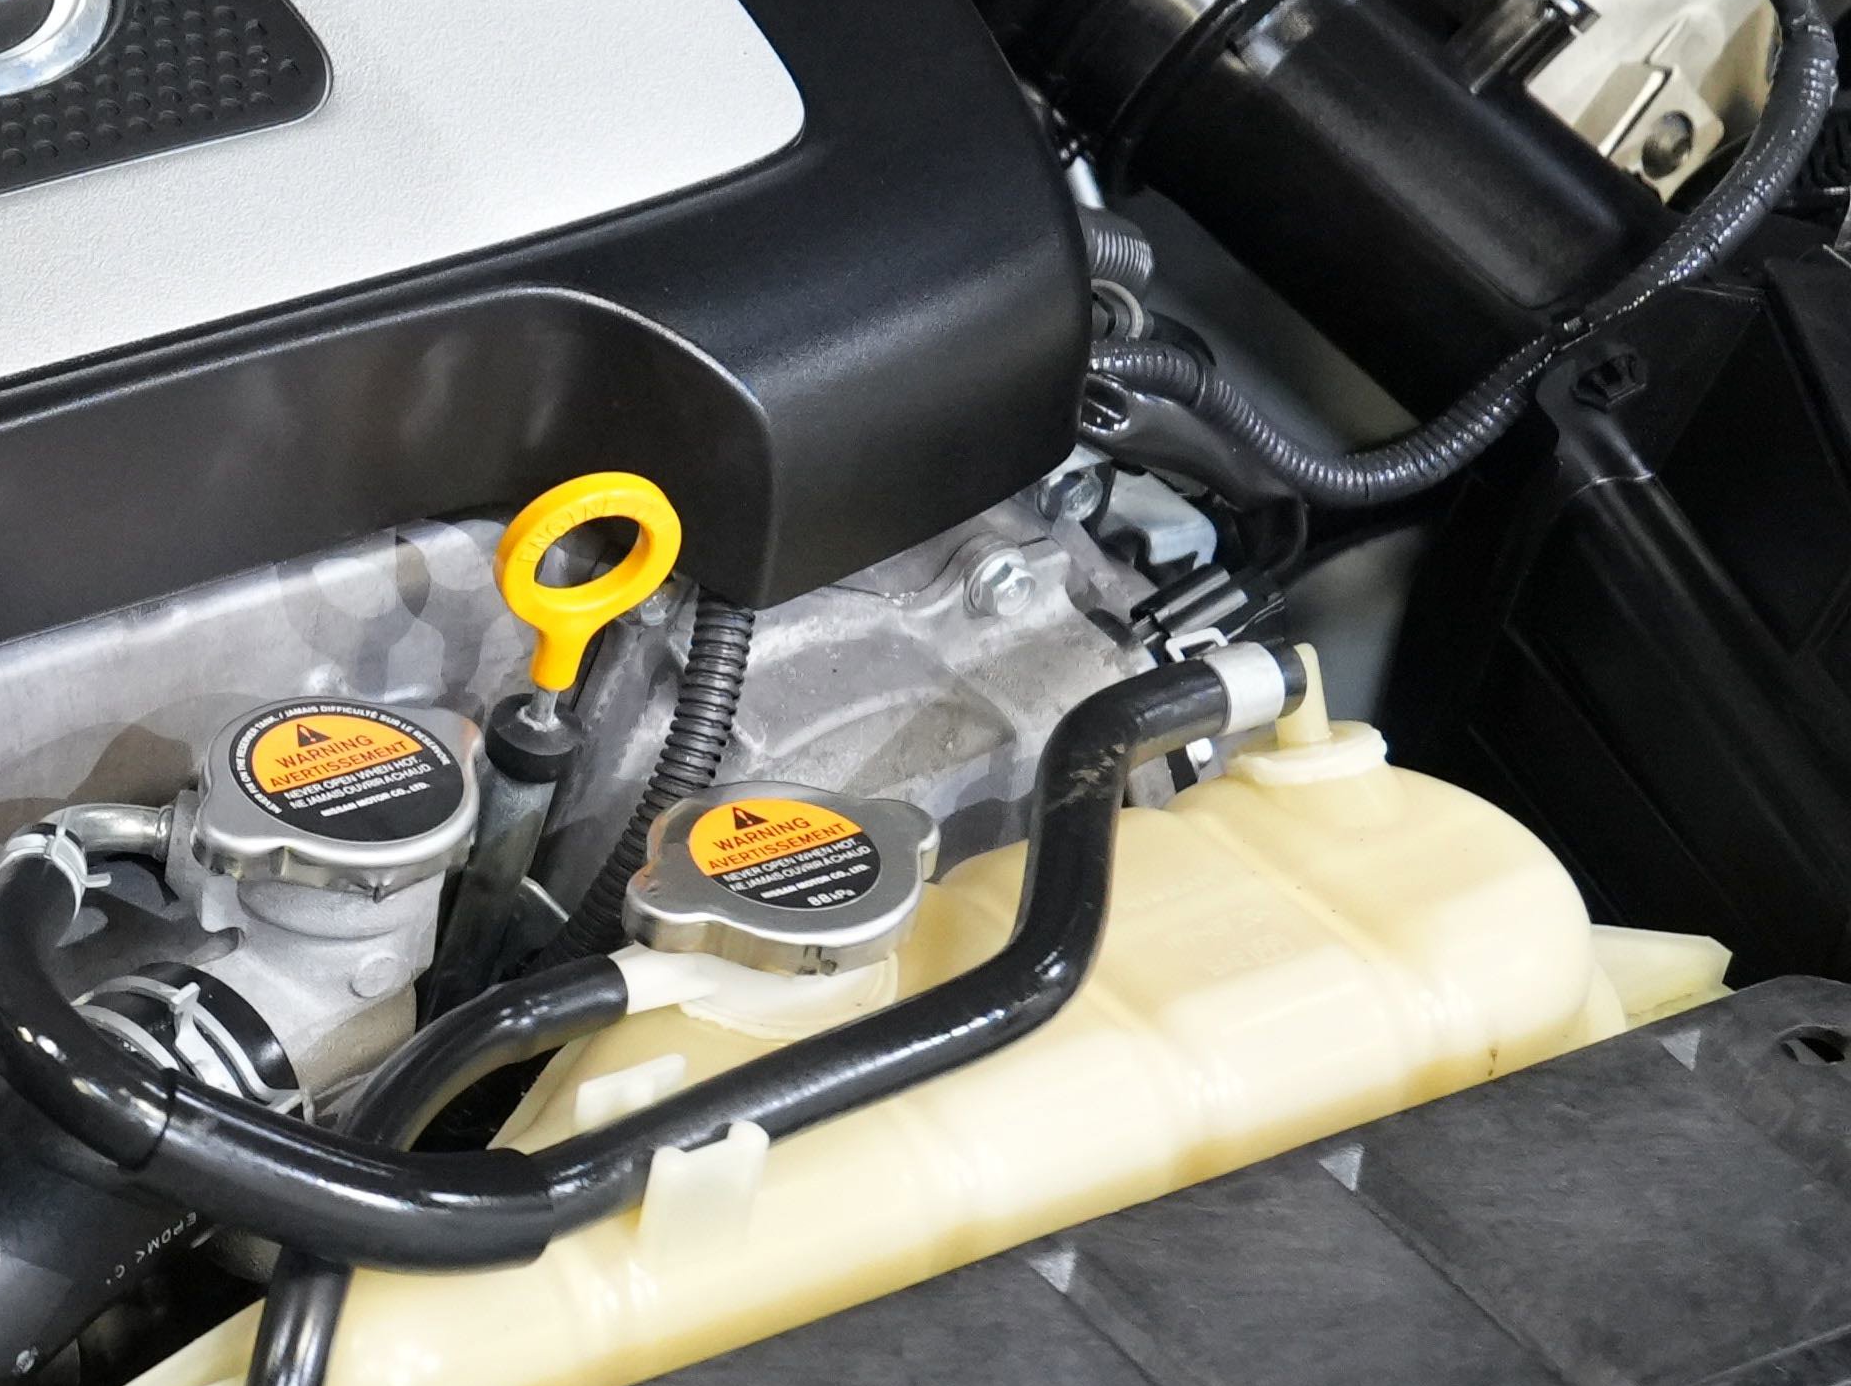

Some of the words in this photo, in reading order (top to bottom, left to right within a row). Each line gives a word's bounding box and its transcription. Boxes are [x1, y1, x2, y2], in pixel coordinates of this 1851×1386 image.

[269, 740, 410, 787] AVERTISSEMENT
[276, 734, 375, 769] WARNING
[284, 780, 324, 800] NEVER
[322, 772, 358, 791] OPEN
[357, 763, 396, 781] WHEN
[289, 797, 309, 810] NE
[307, 789, 345, 808] JAMAIS
[708, 822, 847, 871] AVERTISSEMENT
[712, 817, 811, 852] WARNING
[722, 865, 763, 883] NEVER
[763, 855, 797, 873] OPEN
[794, 845, 833, 862] WHEN
[747, 871, 785, 891] JAMAIS
